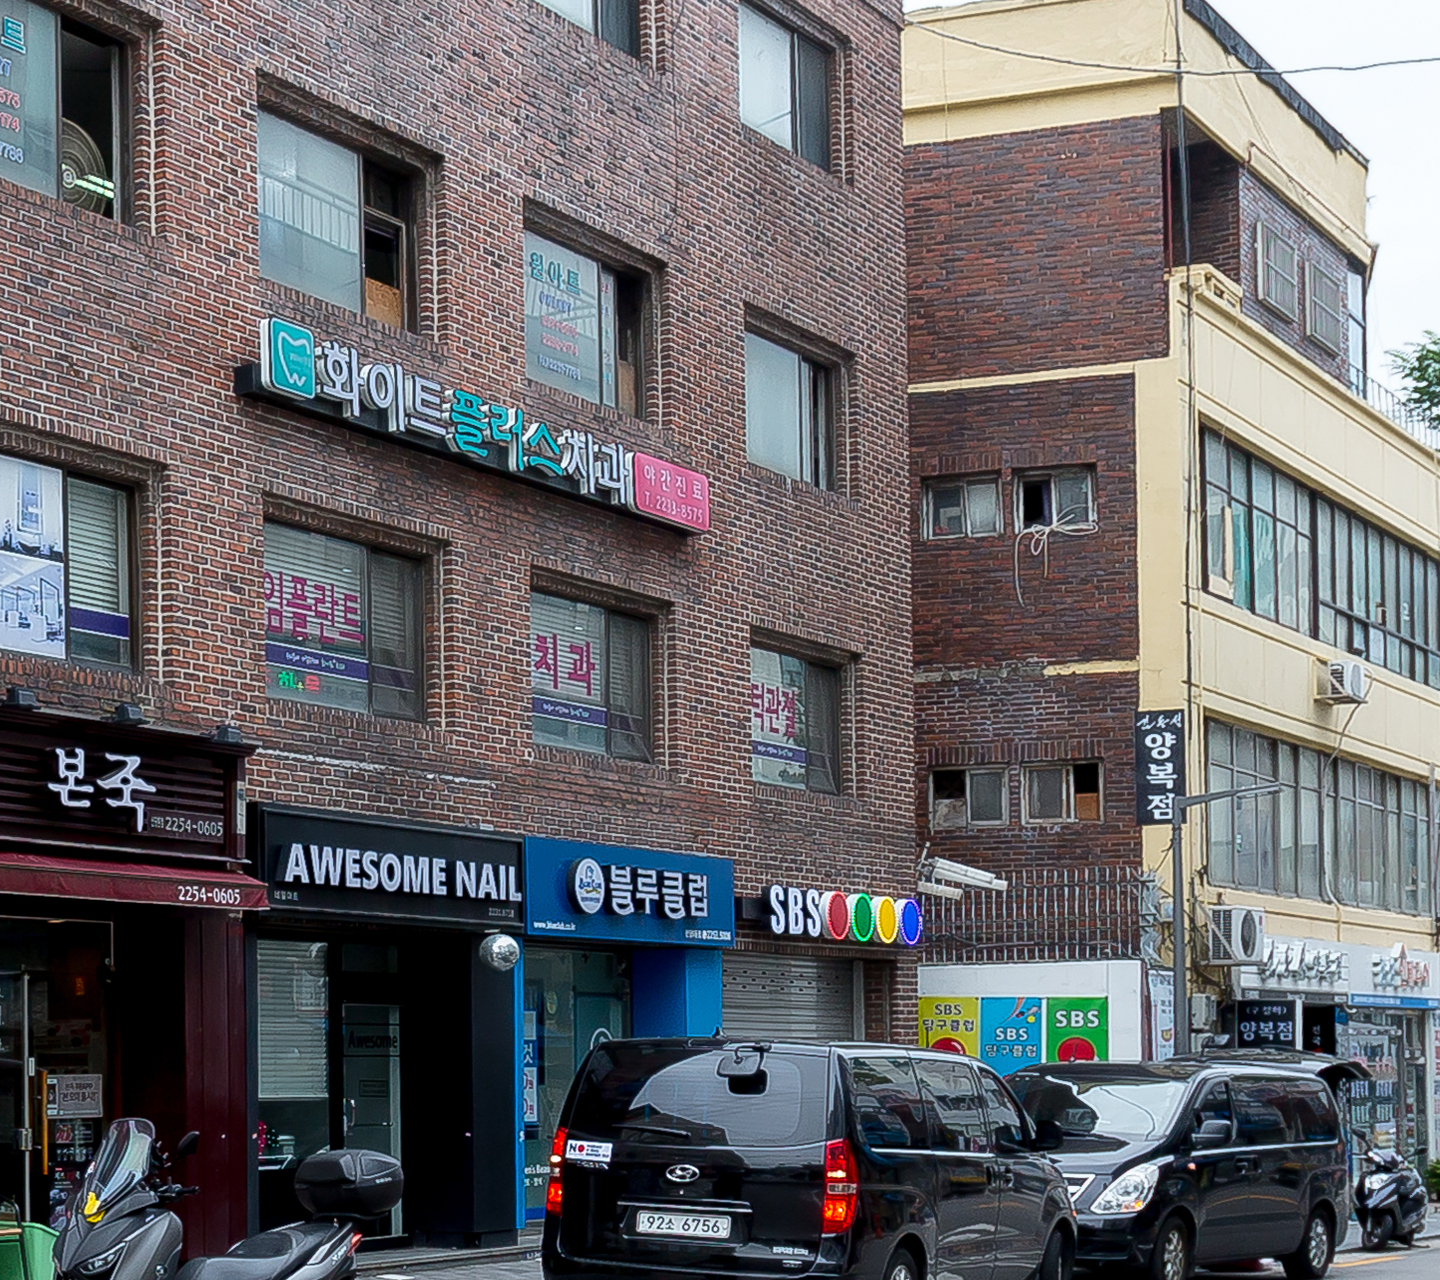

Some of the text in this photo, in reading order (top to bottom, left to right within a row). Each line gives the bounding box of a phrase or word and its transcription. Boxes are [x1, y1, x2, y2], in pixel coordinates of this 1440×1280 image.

[321, 341, 627, 504] 화이트플러스치과
[656, 495, 703, 524] 2233-8575
[534, 633, 596, 697] 치과
[1145, 732, 1178, 820] 양복점
[48, 747, 156, 832] 본죽
[165, 817, 223, 837] 2254-0605
[284, 843, 522, 902] AWESOME NAIL
[178, 885, 240, 904] 2254-0605
[610, 865, 708, 919] 블루클럽
[770, 884, 821, 937] SBS
[934, 1004, 962, 1016] SBS
[1055, 1009, 1100, 1028] SBS
[922, 1019, 975, 1032] 당구클럽
[995, 1027, 1029, 1041] SBS
[1240, 1021, 1293, 1042] 양복점
[985, 1044, 1037, 1058] 당구클럽
[647, 1215, 720, 1233] 92소 6756
